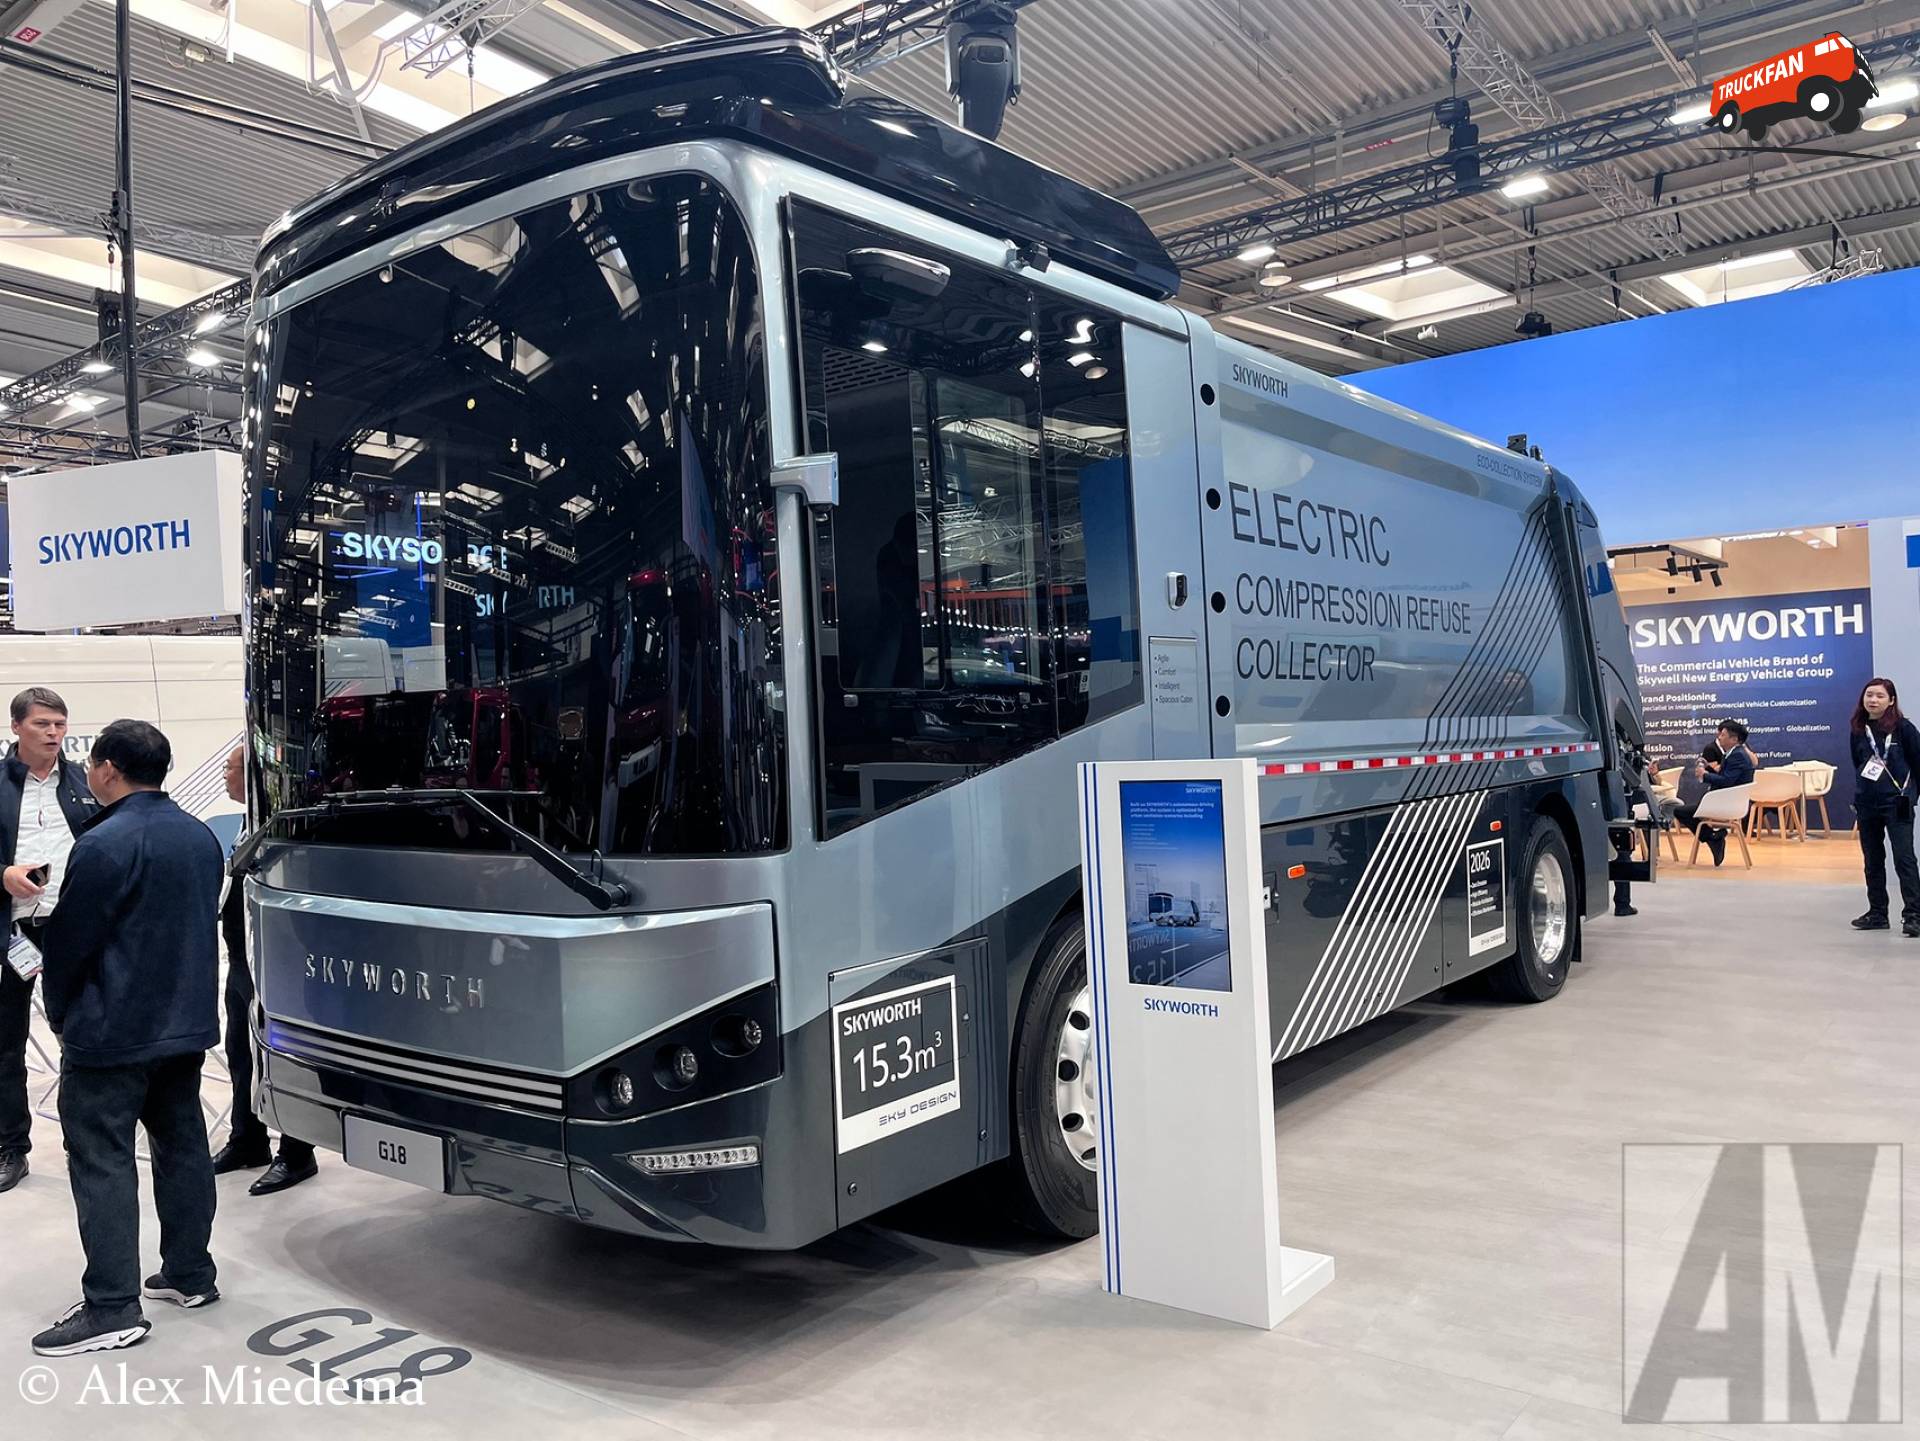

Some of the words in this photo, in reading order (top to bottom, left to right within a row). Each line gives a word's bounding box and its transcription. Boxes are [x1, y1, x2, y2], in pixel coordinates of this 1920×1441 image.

[1232, 363, 1289, 399] SKYWORTH
[1228, 481, 1391, 567] ELECTRIC
[38, 518, 191, 564] SKYWORTH
[1236, 572, 1401, 629] COMPRESSION
[1407, 595, 1472, 636] REFUSE
[1634, 603, 1864, 648] SKYWORTH
[1236, 637, 1375, 682] COLLECTOR
[1637, 663, 1657, 673] The
[1660, 659, 1726, 672] Commercial
[1728, 657, 1770, 668] Vehicle
[1773, 654, 1808, 666] Brand
[1811, 653, 1824, 664] of
[1638, 673, 1680, 687] Skywell
[1682, 673, 1707, 683] New
[1709, 671, 1749, 683] Energy
[1751, 668, 1794, 680] Vehicle
[1796, 667, 1833, 679] Group
[1642, 704, 1667, 712] pecialist
[1707, 701, 1744, 709] Commercial
[1746, 700, 1769, 708] Vehicle
[1770, 698, 1817, 707] Customization
[1666, 692, 1717, 702] Positioning
[1645, 720, 1659, 728] our
[1661, 717, 1700, 728] Strategic
[1786, 723, 1830, 732] Globalization
[1770, 750, 1792, 759] Future
[1470, 849, 1491, 873] 2026
[305, 953, 484, 1008] SKYWORTH
[843, 998, 922, 1036] SKYWORTH
[1144, 998, 1219, 1017] SKYWORTH
[910, 1090, 957, 1114] DESIGN
[378, 1140, 407, 1165] G18
[246, 1307, 473, 1401] G18
